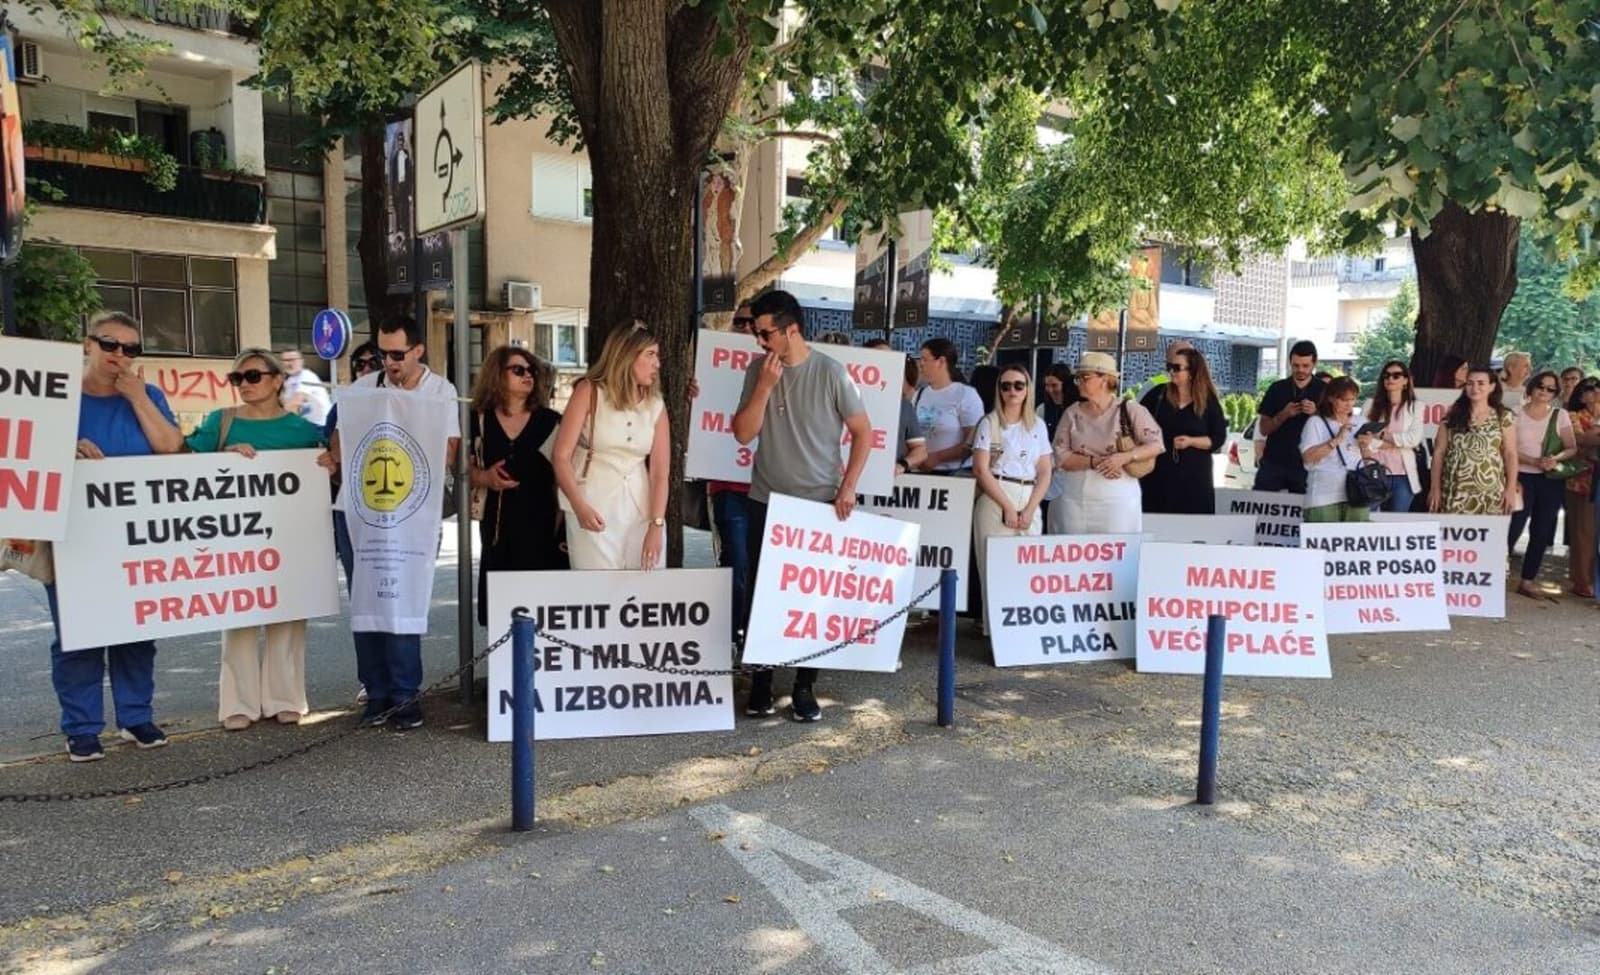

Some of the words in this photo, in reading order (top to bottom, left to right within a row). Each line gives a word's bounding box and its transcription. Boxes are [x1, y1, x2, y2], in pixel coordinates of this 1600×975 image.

[86, 481, 137, 509] NE
[145, 468, 301, 504] TRAŽIMO
[927, 488, 949, 511] JE
[126, 511, 273, 546] LUKSUZ,
[770, 524, 805, 549] SVI
[809, 531, 833, 555] ZA
[838, 536, 912, 567] JEDNOG-
[915, 545, 953, 569] MO
[1017, 542, 1127, 564] MLADOST
[1306, 536, 1400, 553] NAPRAVILI
[1406, 535, 1437, 551] STE
[122, 546, 281, 586] TRAŽIMO
[1186, 566, 1276, 591] MANJE
[1377, 559, 1437, 575] POSAO
[780, 563, 894, 605] POVIŠICA
[1030, 573, 1113, 594] ODLAZI
[1323, 583, 1399, 601] JEDINILI
[1404, 582, 1436, 598] STE
[134, 585, 278, 626] PRAVDU
[619, 596, 710, 629] ĆEMO
[1001, 604, 1066, 627] ZBOG
[1149, 597, 1298, 623] KORUPCIJE
[1358, 607, 1401, 624] NAS.
[783, 610, 818, 640] ZA
[825, 614, 880, 645] SVE!
[1149, 625, 1209, 651] VEĆ
[1227, 629, 1316, 656] PLAĆE
[593, 643, 630, 670] MI
[640, 640, 701, 669] VAS
[1040, 628, 1118, 655] PLAĆA
[555, 680, 723, 712] IZBORIMA.
